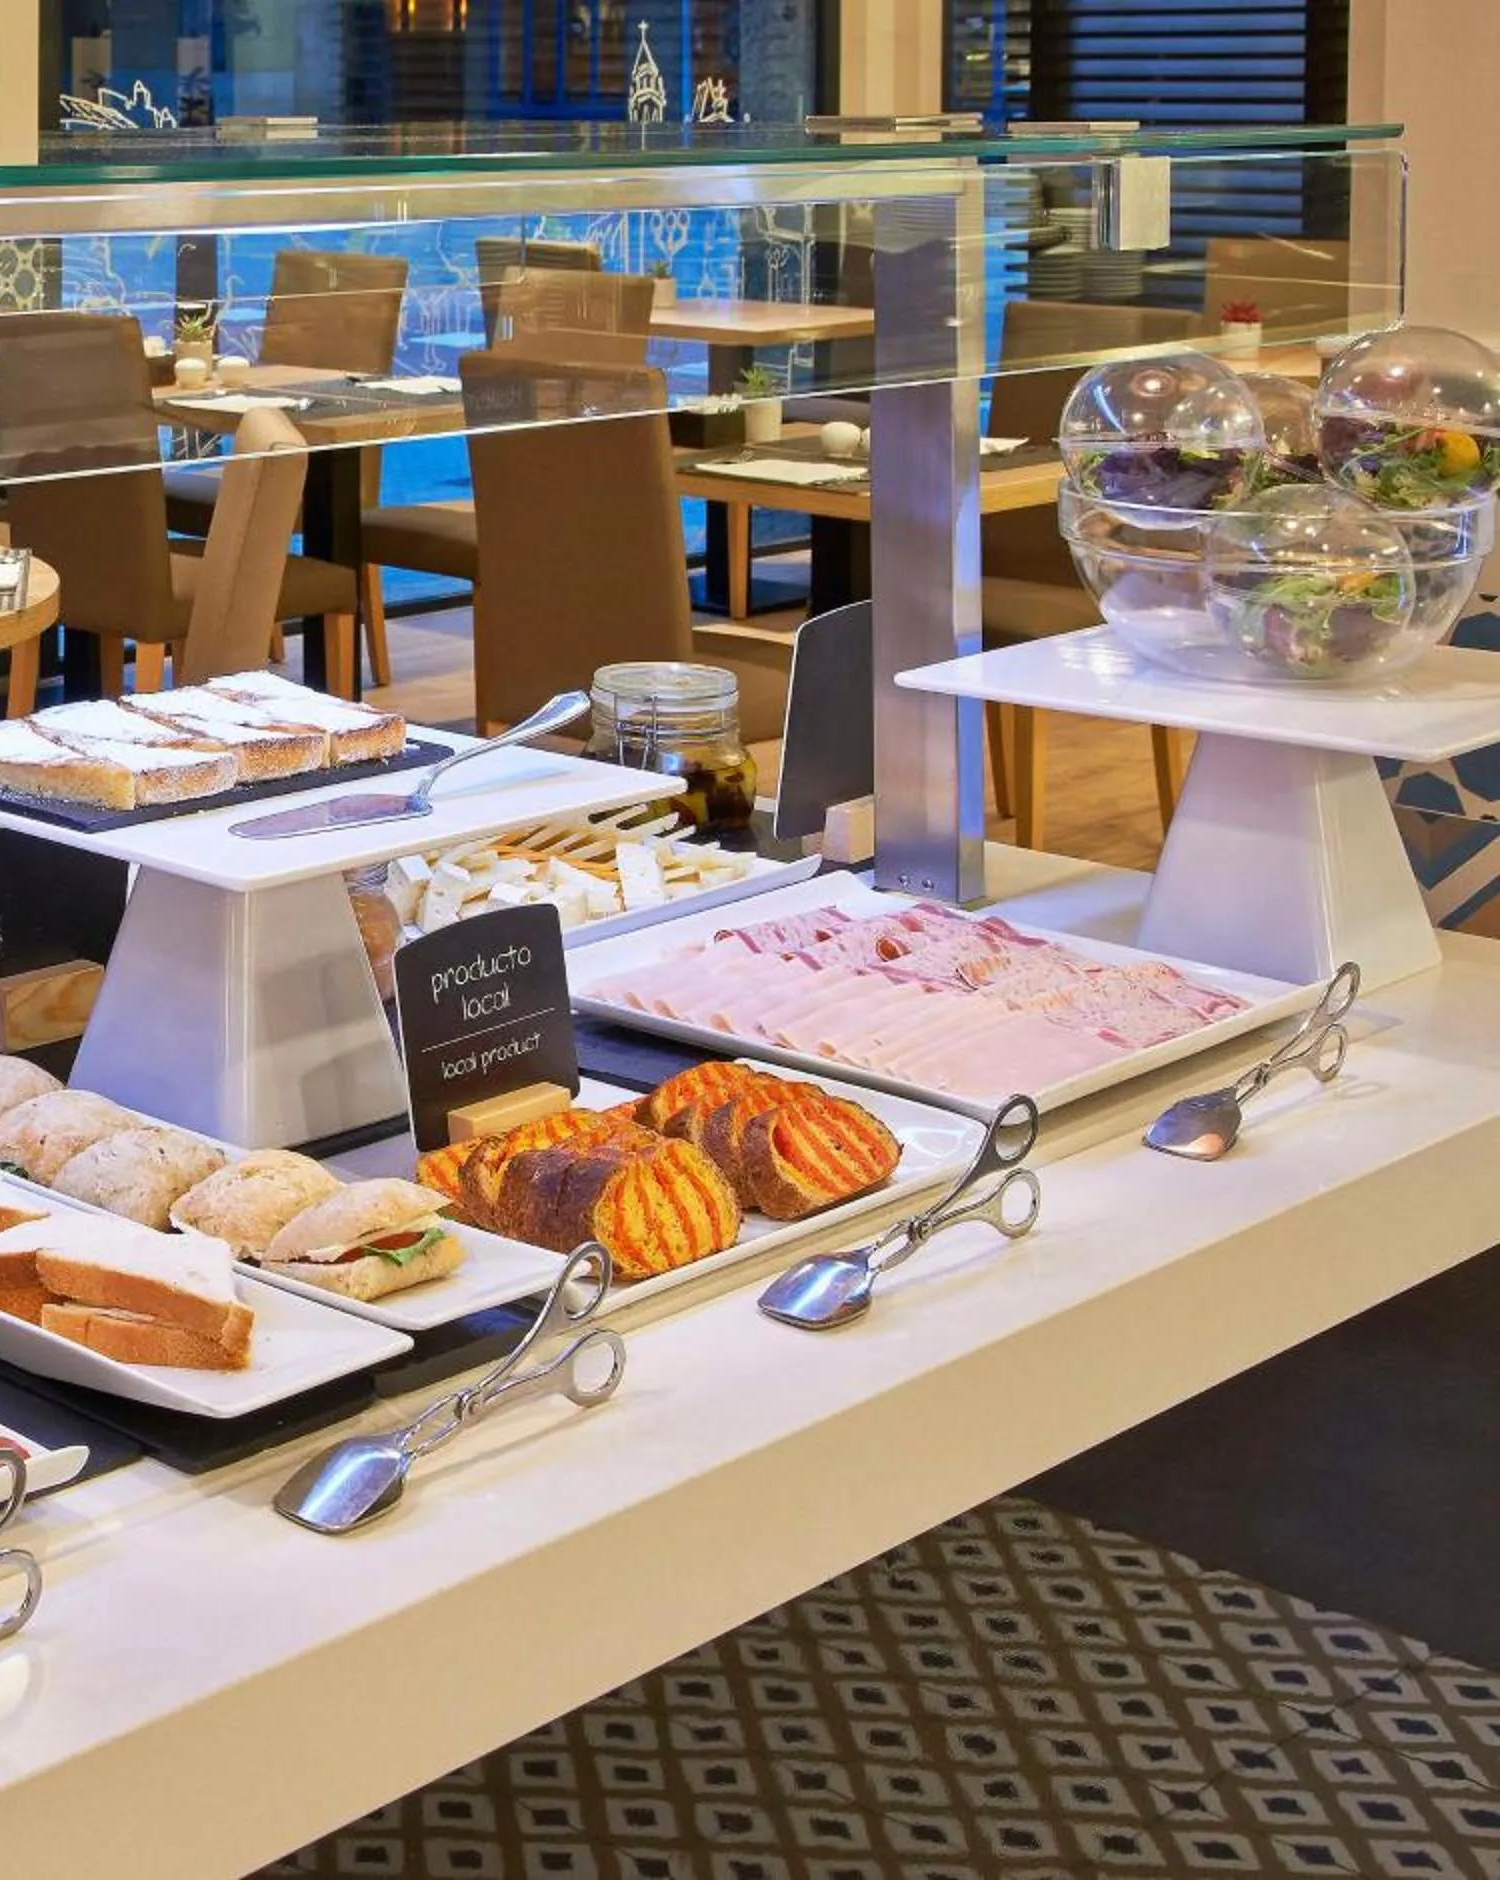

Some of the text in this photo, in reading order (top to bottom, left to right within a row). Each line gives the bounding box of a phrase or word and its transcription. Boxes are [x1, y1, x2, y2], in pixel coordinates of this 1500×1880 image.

[430, 945, 531, 1004] producto
[461, 982, 511, 1021] local
[442, 1031, 542, 1080] local product
